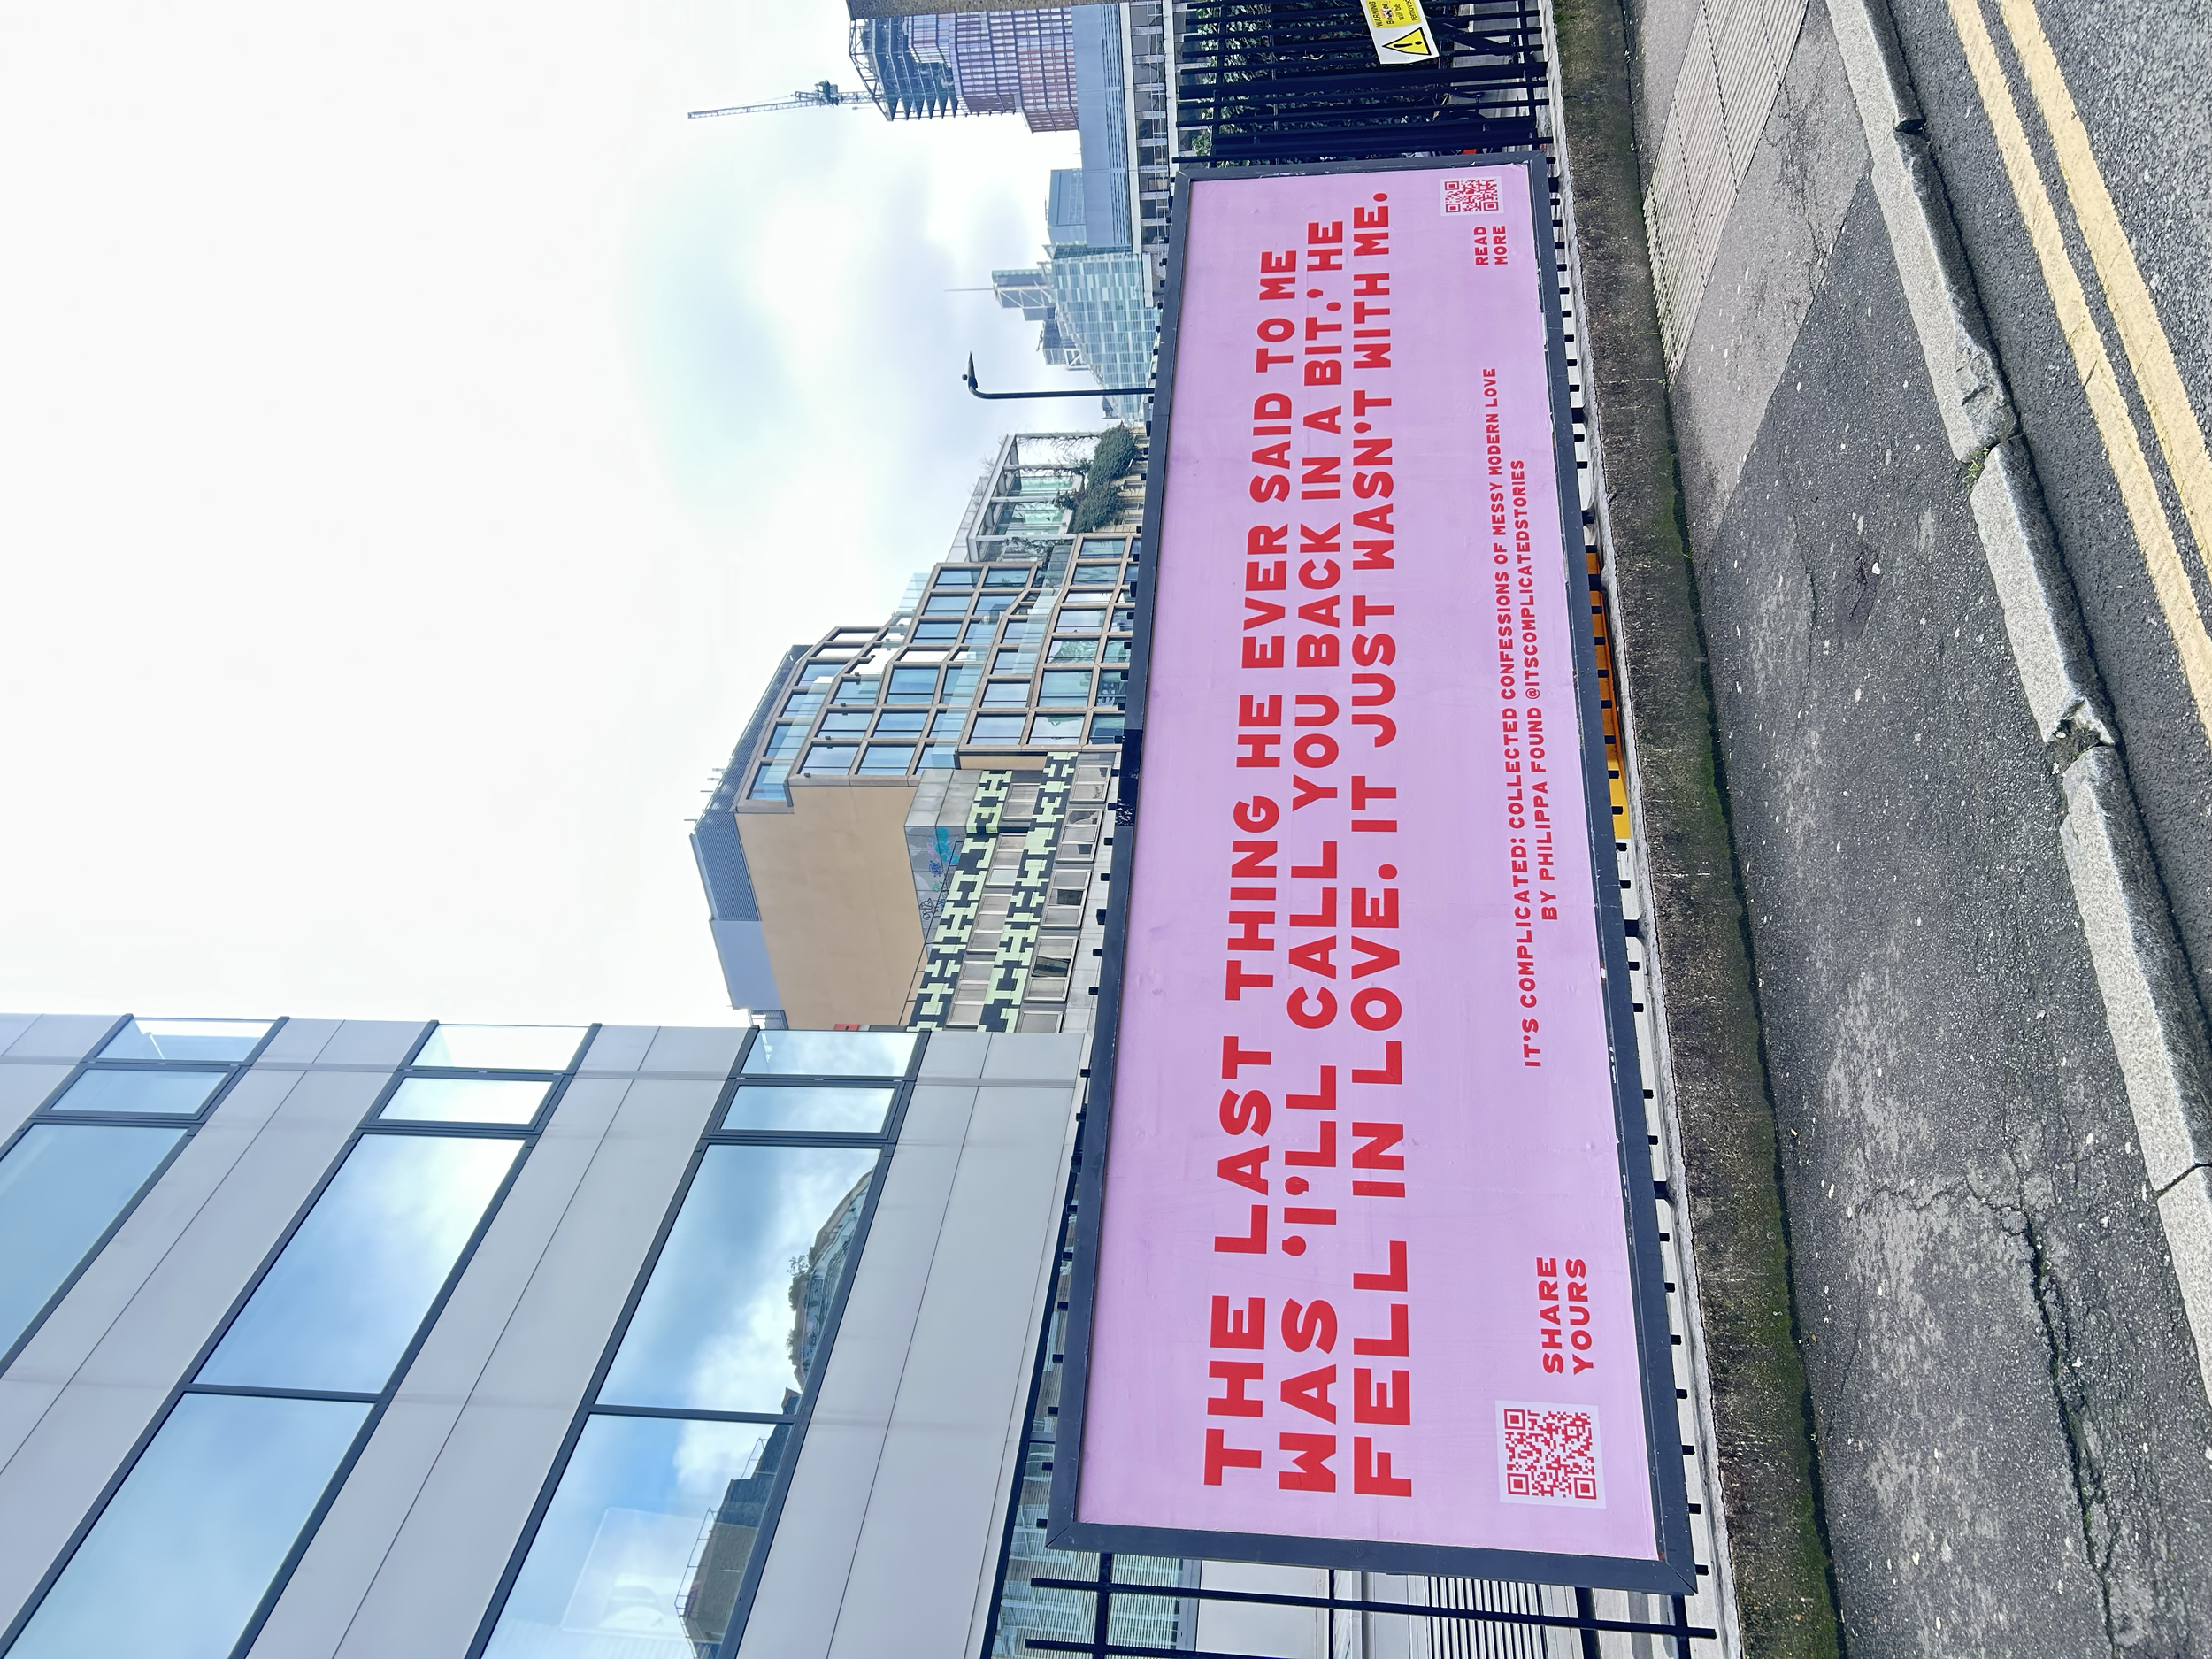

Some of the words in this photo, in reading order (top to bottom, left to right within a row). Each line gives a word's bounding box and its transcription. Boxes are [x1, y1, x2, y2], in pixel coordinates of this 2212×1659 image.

[1368, 1, 1383, 27] WARNING
[1306, 220, 1343, 272] HE
[1353, 192, 1389, 257] ME.
[1472, 225, 1490, 266] READ
[1491, 224, 1509, 266] MORE
[1258, 250, 1297, 300] ME
[1353, 273, 1392, 369] WITH
[1256, 317, 1295, 373] TO
[1482, 368, 1497, 407] LOVE
[1249, 392, 1292, 503] SAID
[1302, 405, 1341, 434] A
[1486, 413, 1502, 475] MODERN
[1301, 457, 1341, 500] IN
[1490, 482, 1505, 535] MESSY
[1241, 524, 1288, 669] EVER
[1296, 522, 1341, 668] BACK
[1493, 542, 1508, 565] OF
[1510, 460, 1539, 697] @ITSCOMPLICATEDSTORIES
[1351, 595, 1397, 748] JUST
[1494, 572, 1516, 700] CONFESSIONS
[1235, 694, 1282, 768] HE
[1292, 694, 1340, 810] YOU
[1502, 707, 1525, 829] COLLECTED
[1526, 707, 1546, 772] FOUND
[1350, 775, 1397, 833] IT
[1532, 781, 1555, 880] PHILIPPA
[1225, 795, 1279, 1001] THING
[1286, 841, 1338, 1029] CALL
[1510, 838, 1537, 1008] COMPLICATED:
[1540, 891, 1558, 920] BY
[1350, 864, 1402, 1085] LOVE.
[1214, 1035, 1271, 1254] LAST
[1351, 1121, 1406, 1198] IN
[1536, 1257, 1564, 1373] SHARE
[1565, 1258, 1594, 1374] YOURS
[1203, 1295, 1265, 1486] THE
[1278, 1298, 1338, 1493] WAS
[1353, 1240, 1412, 1497] FELL
